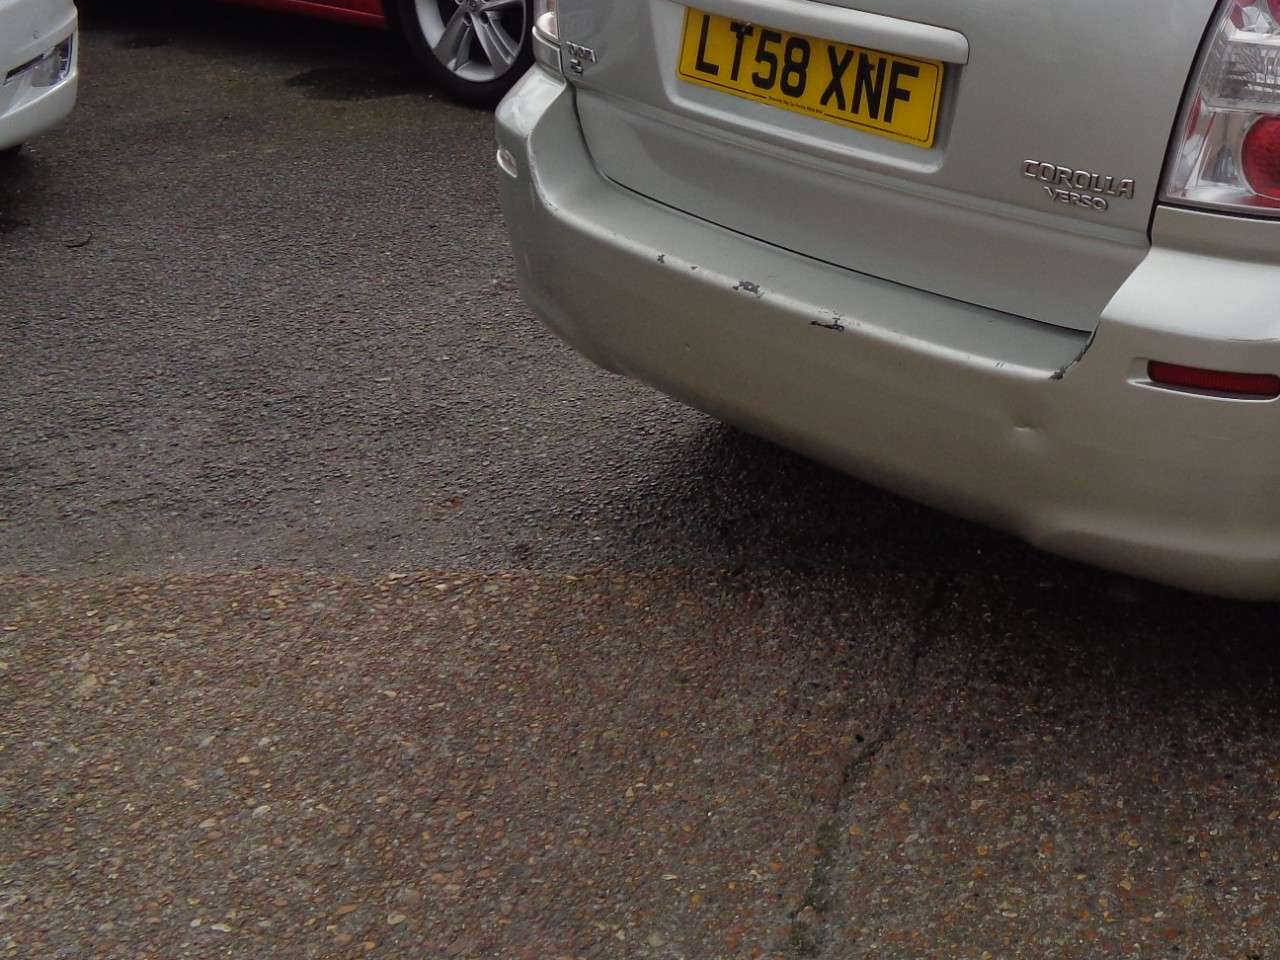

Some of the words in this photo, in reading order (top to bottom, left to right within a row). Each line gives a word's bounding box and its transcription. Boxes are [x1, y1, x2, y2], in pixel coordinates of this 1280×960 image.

[695, 14, 811, 98] LT58
[819, 45, 921, 124] XNF
[1023, 159, 1136, 201] COROLLA
[1043, 186, 1109, 211] VERSO
